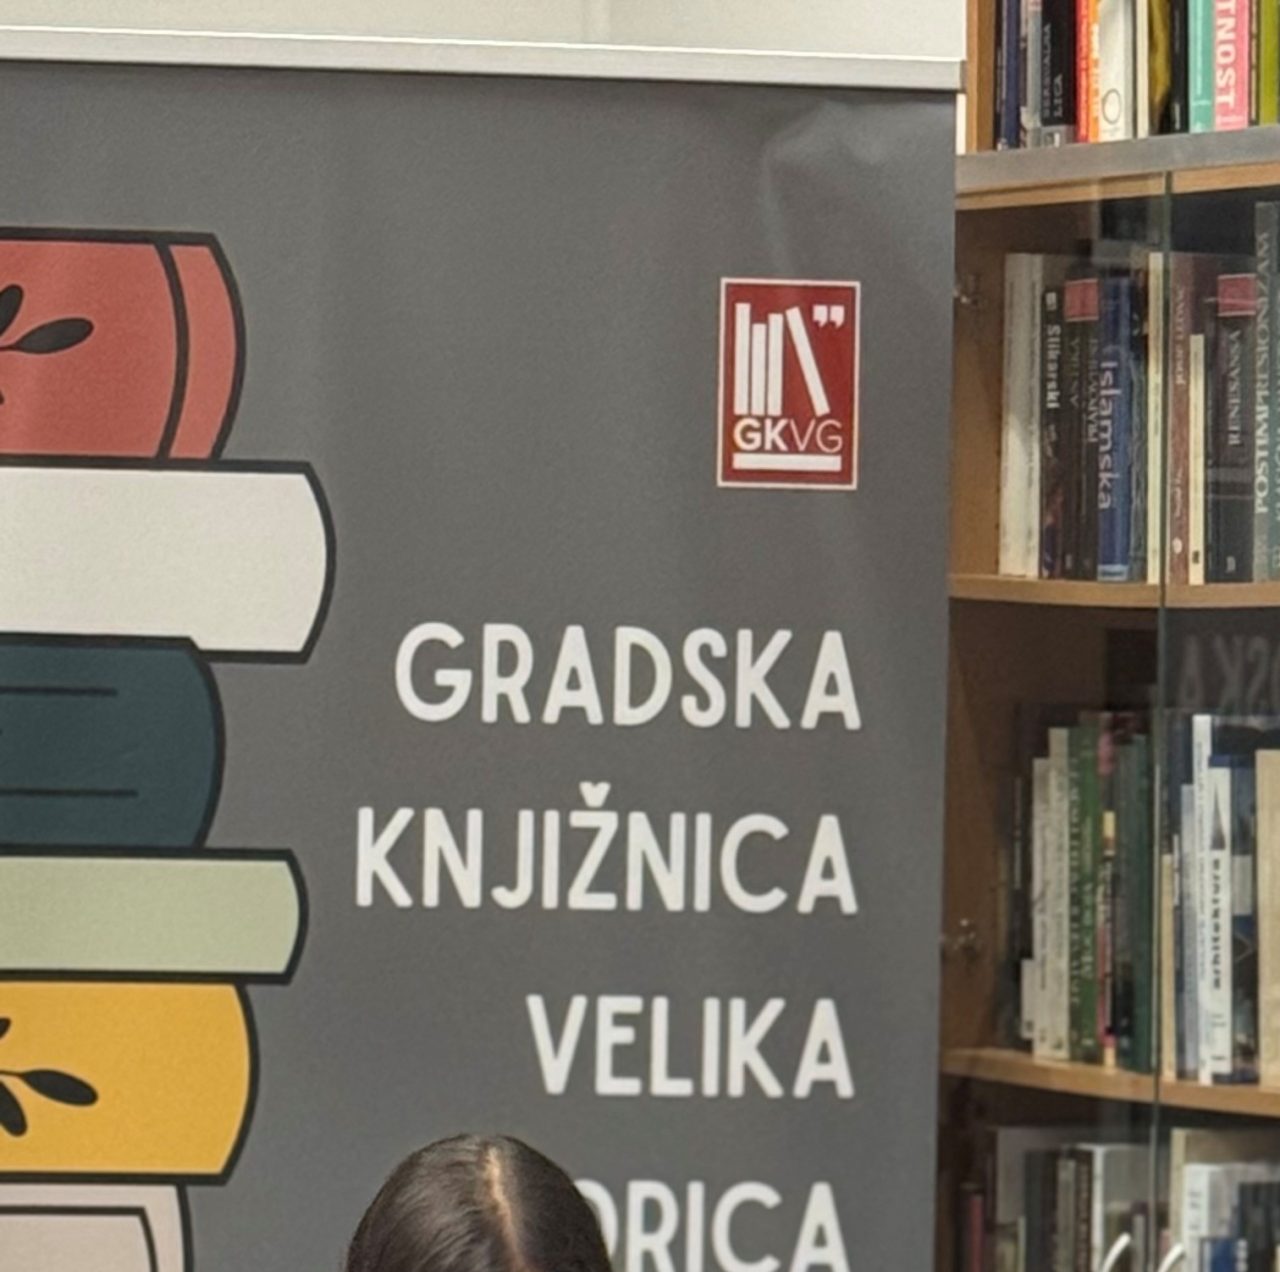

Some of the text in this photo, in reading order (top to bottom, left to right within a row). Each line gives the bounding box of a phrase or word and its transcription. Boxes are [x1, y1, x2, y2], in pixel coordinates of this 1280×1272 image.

[1227, 328, 1242, 447] RENESANSA
[1254, 231, 1270, 515] POSTIMPRESIONIZAM
[733, 418, 843, 453] GKVG
[1097, 360, 1123, 511] Islamska
[395, 622, 862, 729] GRADSKA
[356, 781, 859, 914] KNJIŽNICA
[526, 994, 854, 1098] VELIKA
